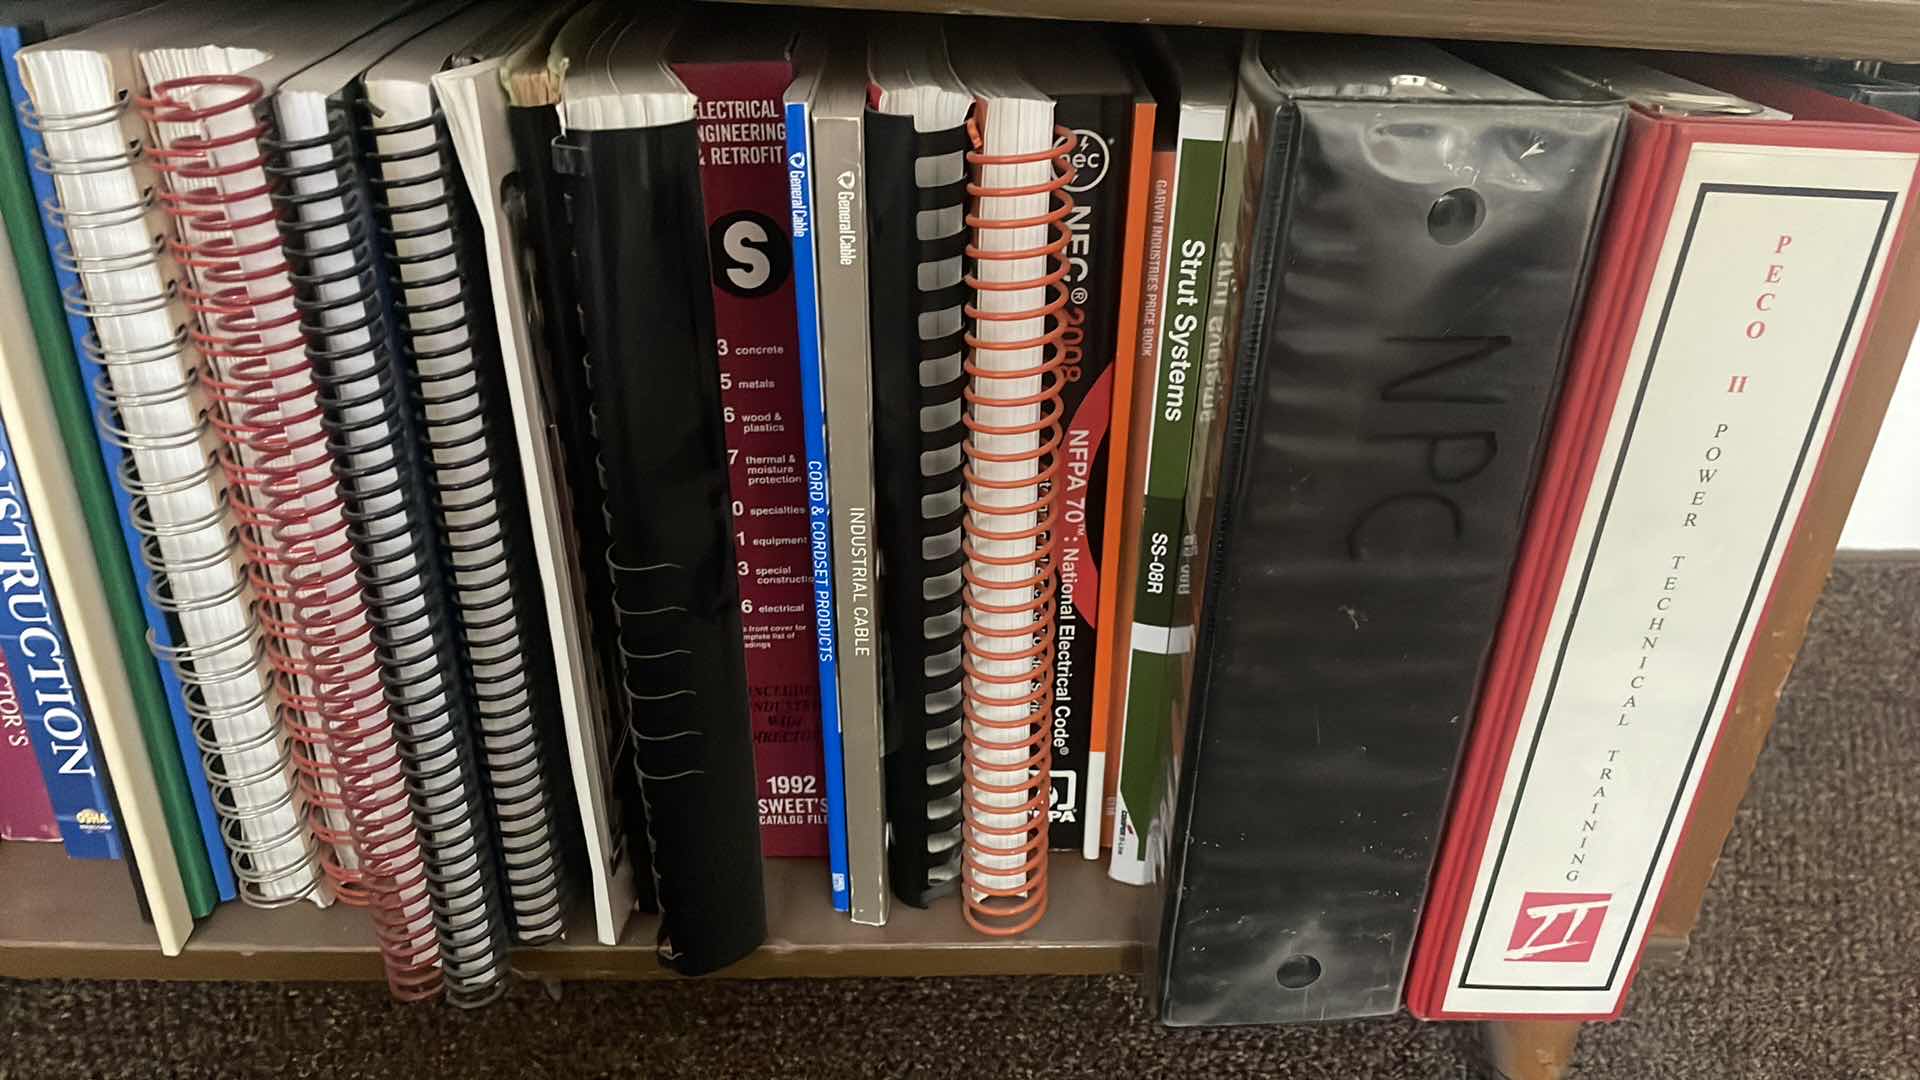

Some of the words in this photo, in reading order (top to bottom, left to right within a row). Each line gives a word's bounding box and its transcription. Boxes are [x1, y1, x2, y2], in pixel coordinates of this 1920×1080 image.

[697, 100, 779, 119] LECTRICAL
[697, 123, 786, 142] NGINEERING
[711, 146, 783, 165] RETROFIT
[790, 171, 807, 209] General
[1152, 180, 1167, 223] GARVIN
[792, 210, 809, 237] Cable
[838, 191, 856, 233] General
[840, 235, 857, 265] Cable
[1147, 225, 1164, 291] INDUSTRIES
[1176, 239, 1206, 307] Strut
[1746, 235, 1792, 340] PECO
[1144, 293, 1159, 327] PRICE
[717, 338, 729, 356] 3
[735, 346, 784, 356] concrete
[1141, 329, 1155, 357] BOOK
[720, 373, 732, 390] 5
[738, 379, 775, 389] metals
[1165, 314, 1198, 422] Systems
[723, 406, 736, 423] 6
[741, 412, 771, 422] wood
[774, 412, 782, 421] &
[743, 424, 784, 434] plastics
[727, 449, 739, 465] 7
[746, 455, 786, 464] thermal
[789, 455, 796, 463] &
[747, 465, 794, 474] moisture
[1067, 430, 1089, 492] NFPA
[748, 475, 802, 485] protection
[808, 460, 825, 502] CORD
[1684, 423, 1728, 527] POWER
[750, 506, 806, 516] specialties
[811, 506, 824, 516] &
[812, 521, 829, 586] CORDSET
[850, 508, 868, 603] INDUSTRIAL
[1147, 532, 1169, 595] SS-08R
[755, 566, 792, 577] special
[757, 576, 815, 584] constructio
[1060, 548, 1080, 619] National
[758, 604, 804, 613] electrical
[816, 590, 833, 663] PRODUCTS
[854, 607, 870, 657] CABLE
[1617, 555, 1685, 726] TECHNICAL
[1056, 625, 1076, 701] Electrical
[0, 663, 29, 746] CTOR'S
[766, 775, 816, 794] 1992
[758, 798, 828, 814] SWEET'S
[759, 815, 803, 825] CATALOG
[1566, 749, 1620, 882] TRAINING
